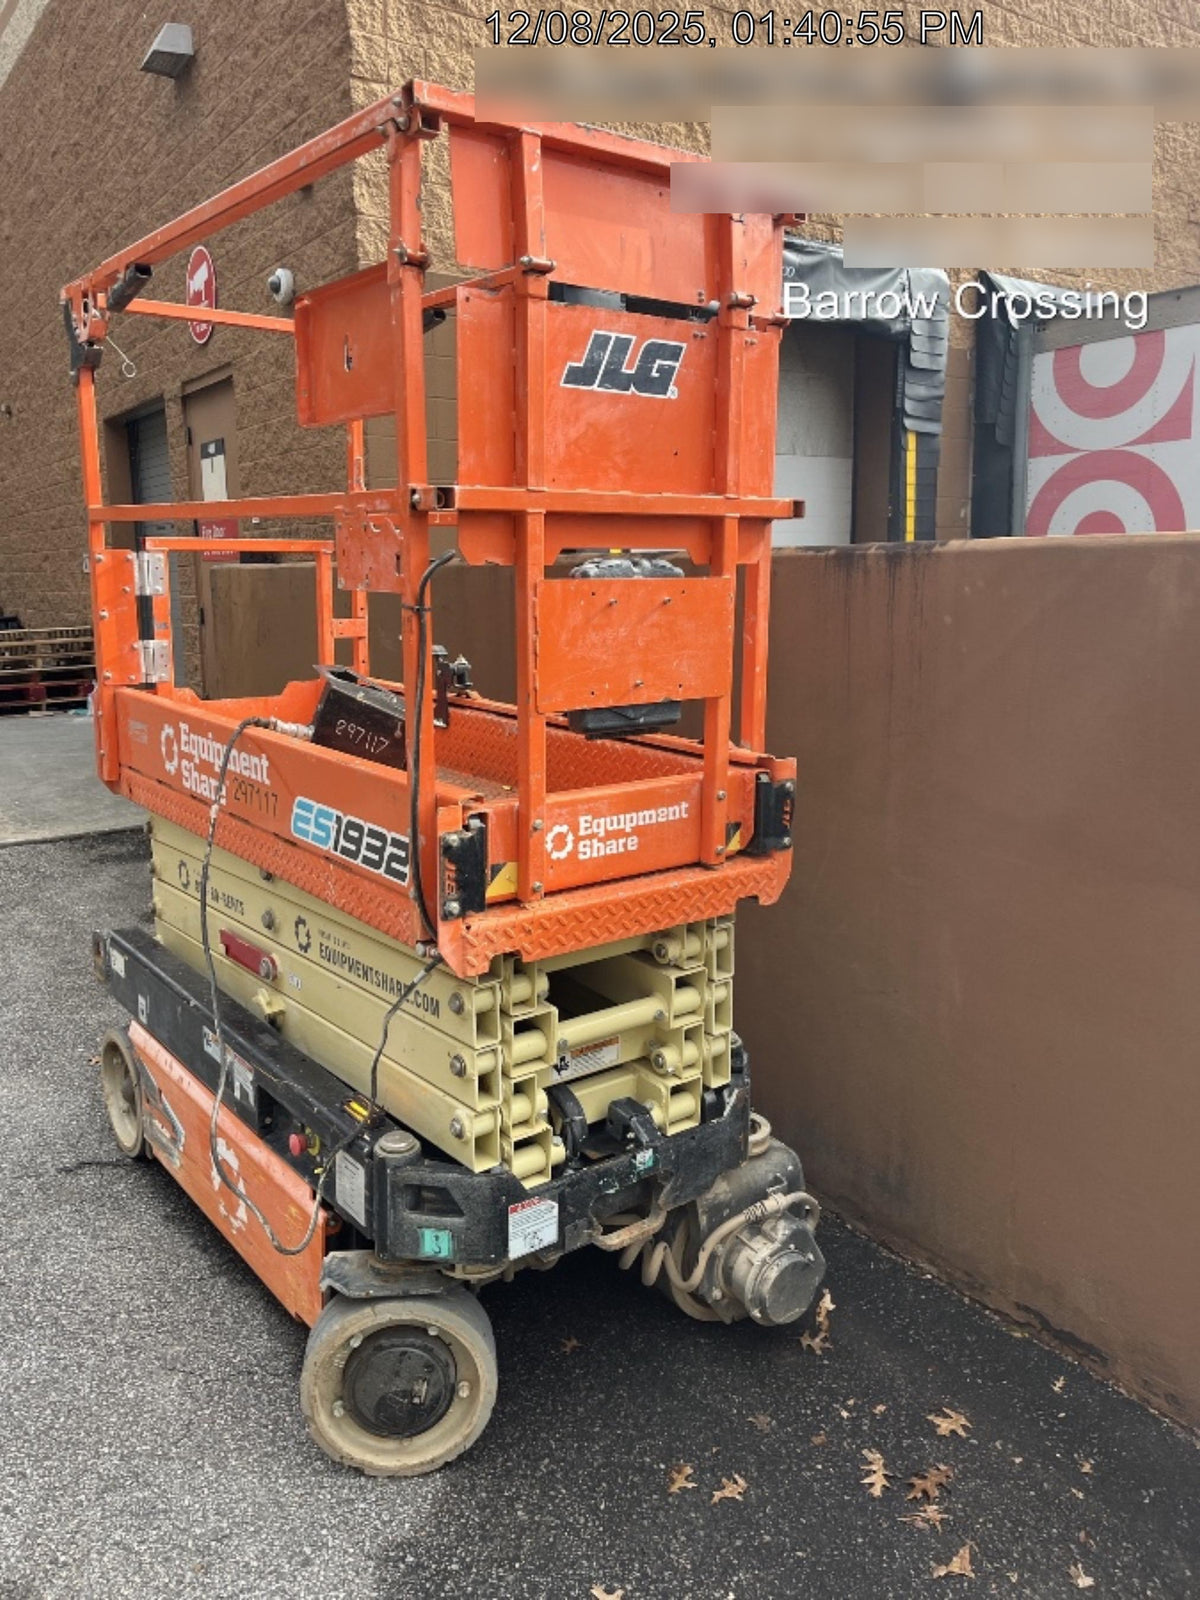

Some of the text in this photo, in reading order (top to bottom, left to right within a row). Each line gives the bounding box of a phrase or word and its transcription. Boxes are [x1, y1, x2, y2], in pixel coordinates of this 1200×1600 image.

[560, 329, 687, 399] JLG
[179, 721, 271, 786] Equipment
[335, 719, 390, 754] 297117
[291, 796, 410, 887] ES1932
[578, 801, 689, 838] Equipment
[577, 834, 639, 860] Share
